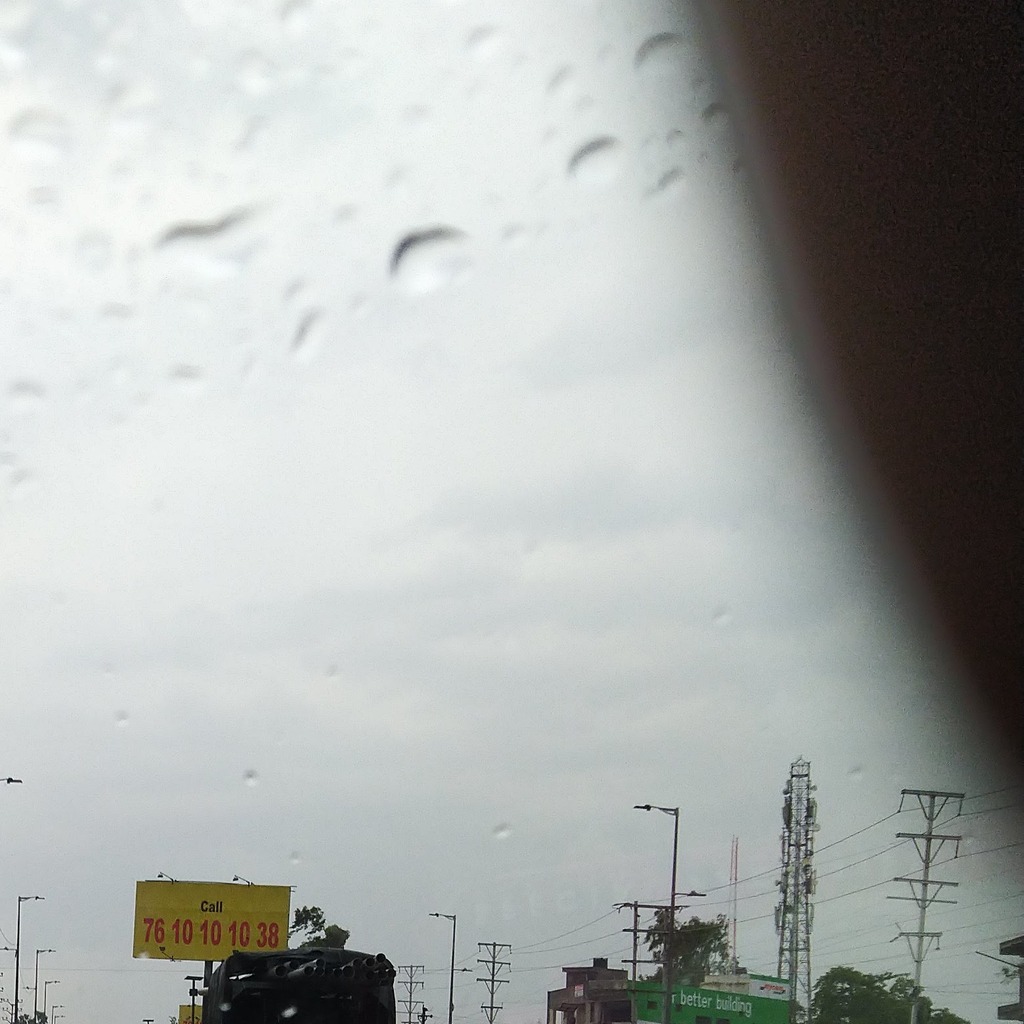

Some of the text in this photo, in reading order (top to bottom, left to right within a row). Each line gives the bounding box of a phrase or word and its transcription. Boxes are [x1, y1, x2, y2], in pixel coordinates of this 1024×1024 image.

[200, 900, 223, 913] Call
[143, 917, 280, 949] 76 10 10 10 38
[680, 990, 711, 1008] better
[716, 995, 753, 1018] building
